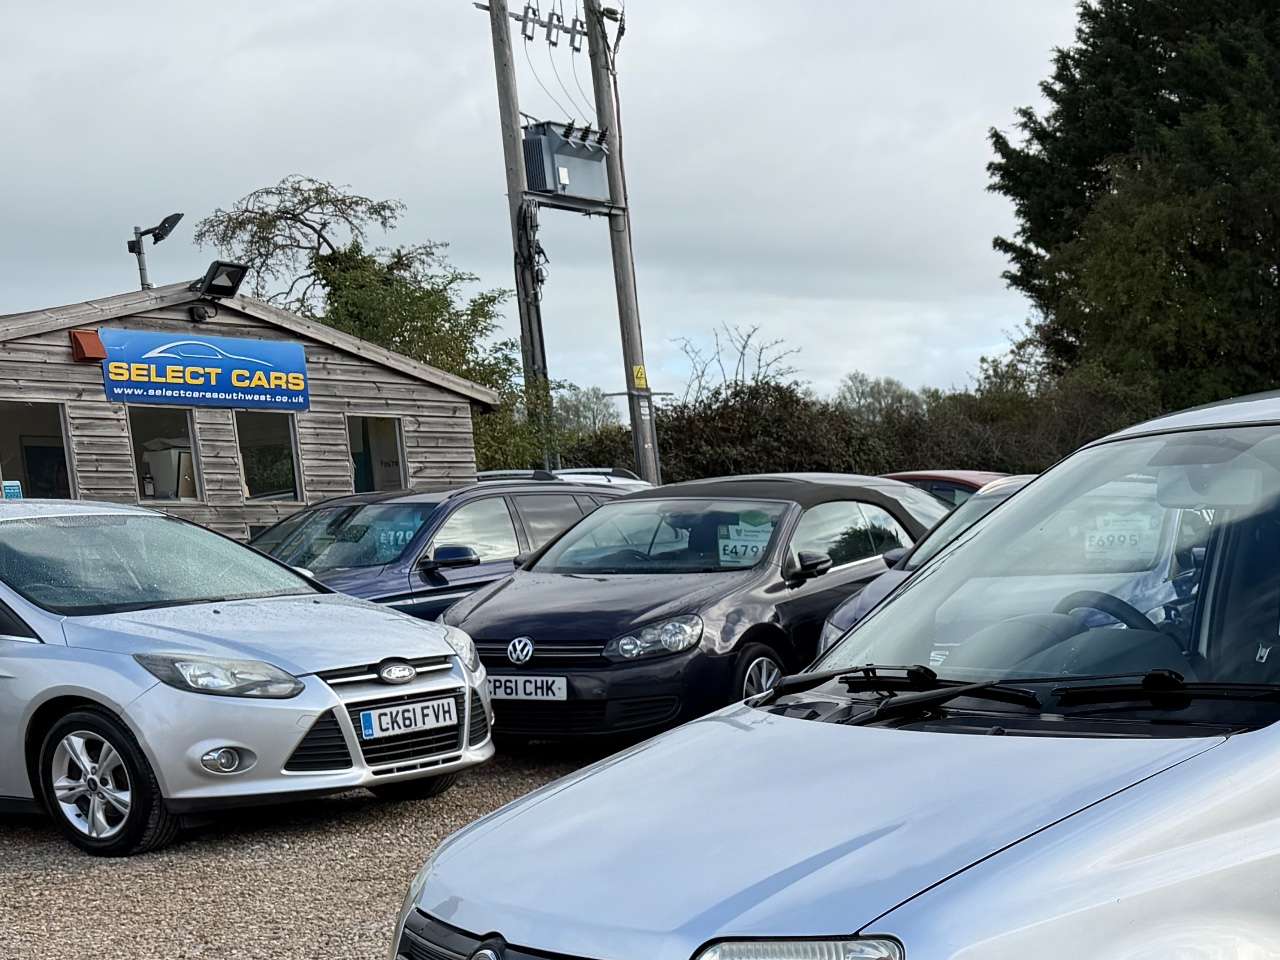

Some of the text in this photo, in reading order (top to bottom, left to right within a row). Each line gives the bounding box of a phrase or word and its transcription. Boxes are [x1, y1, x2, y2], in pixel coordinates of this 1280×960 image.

[108, 362, 305, 391] SELECT CARS
[113, 387, 304, 403] www.selectcarssouthwest.co.uk
[523, 679, 556, 697] CHK
[378, 706, 453, 732] CK61 FVH
